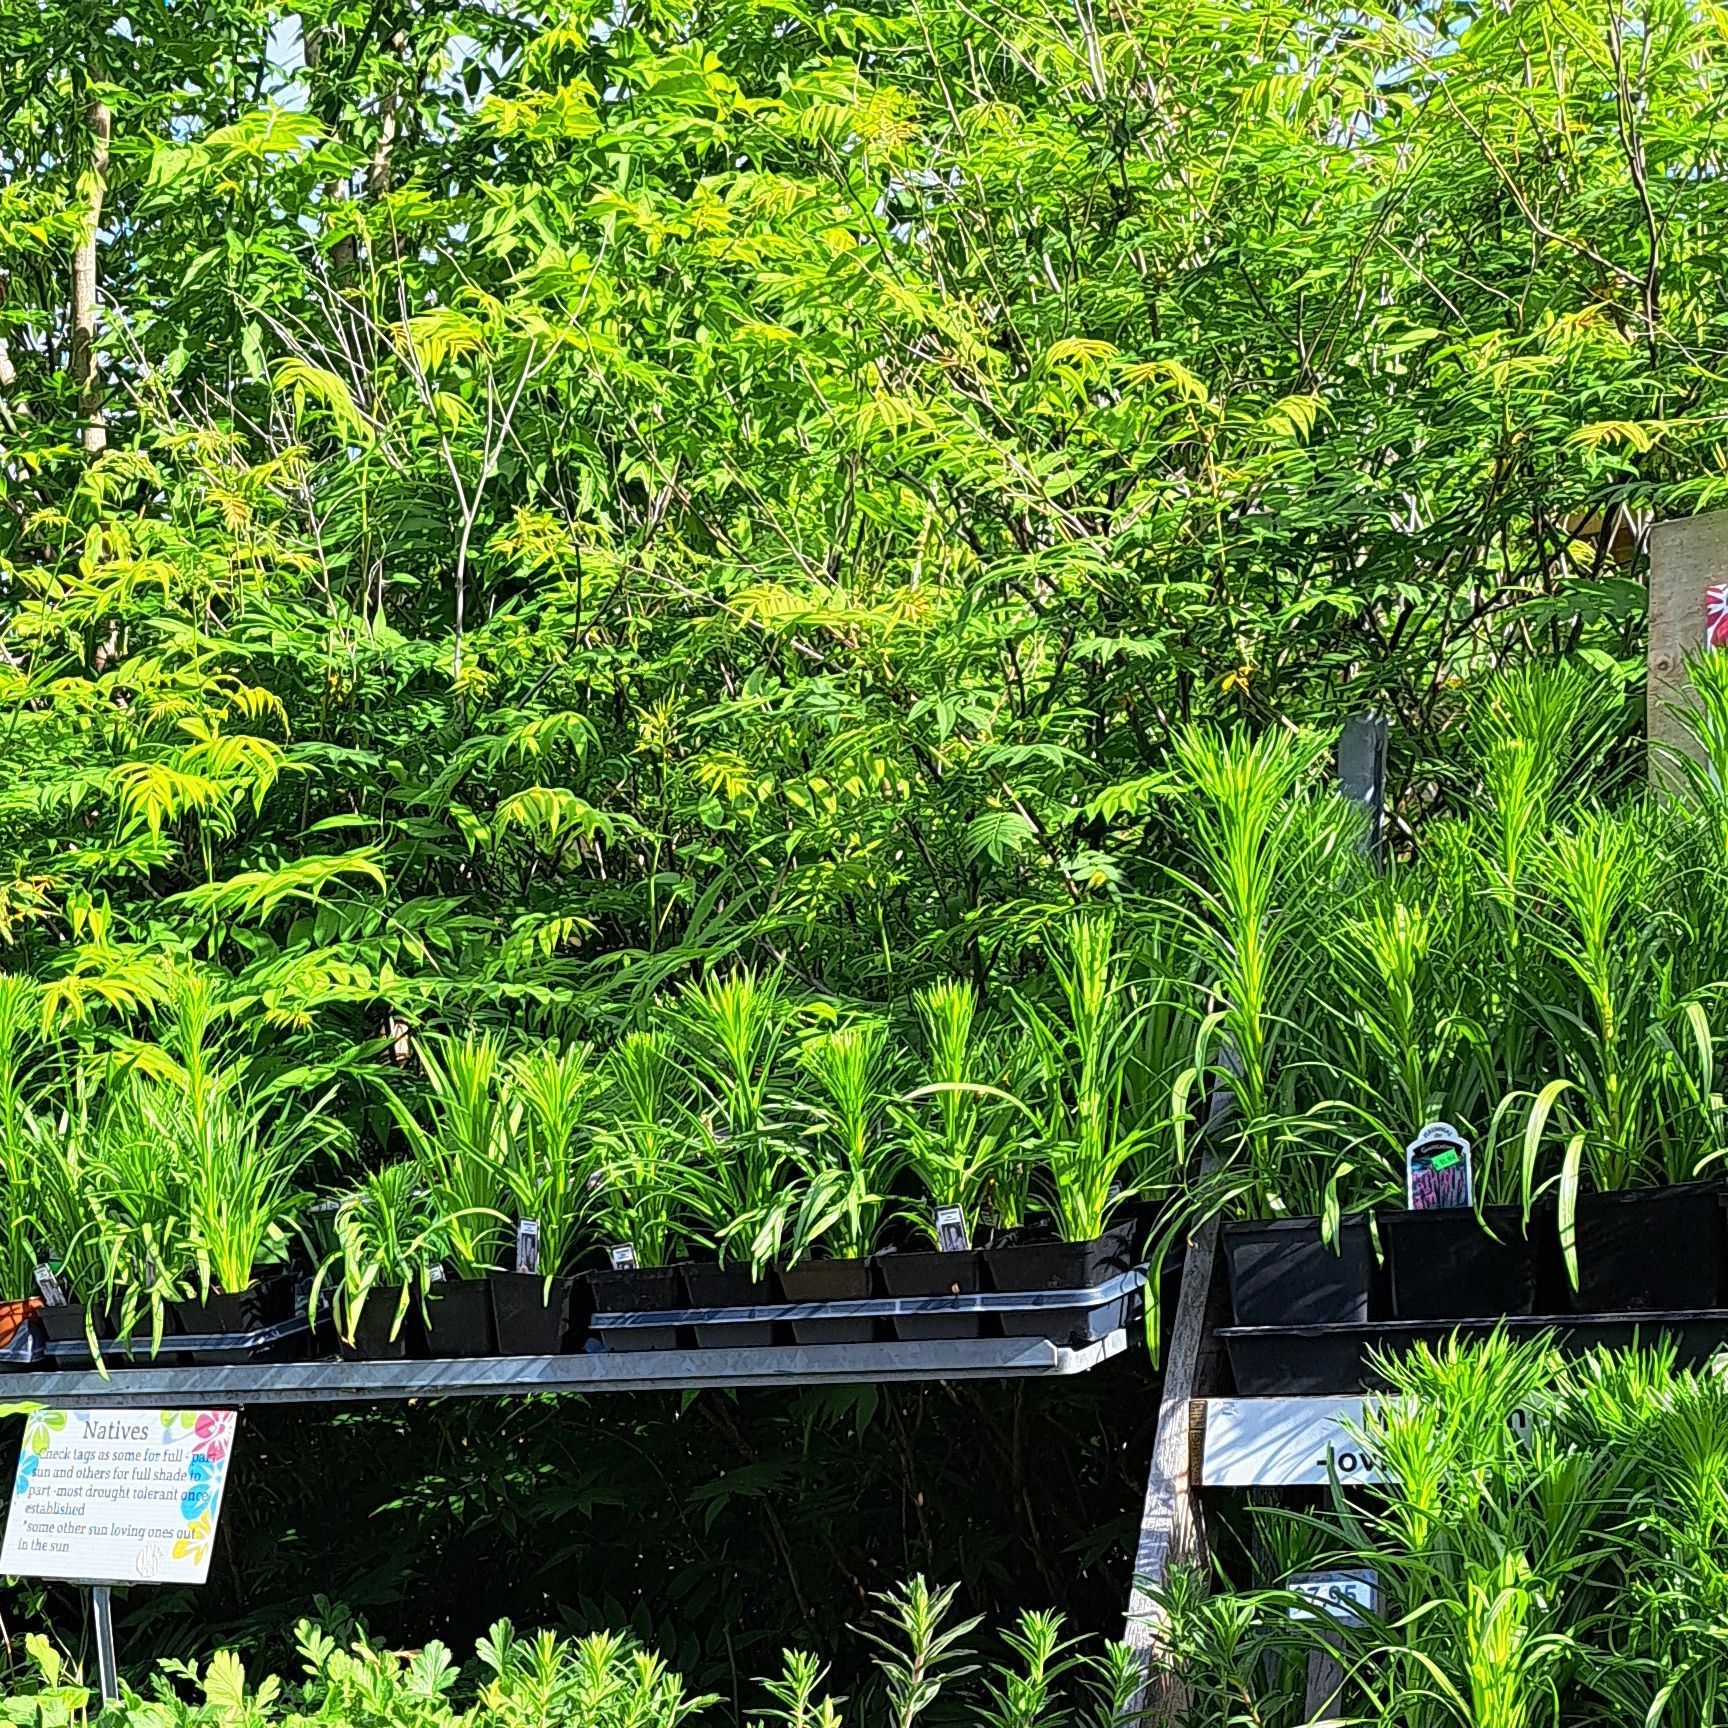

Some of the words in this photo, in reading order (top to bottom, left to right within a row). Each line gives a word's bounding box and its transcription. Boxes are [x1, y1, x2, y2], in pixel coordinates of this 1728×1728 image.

[82, 1420, 150, 1441] Natives
[73, 1450, 96, 1466] tags
[97, 1453, 110, 1462] as
[112, 1453, 141, 1462] some
[143, 1450, 161, 1462] for
[162, 1450, 183, 1463] full
[31, 1467, 51, 1478] sun
[53, 1466, 73, 1479] and
[75, 1466, 110, 1480] others
[112, 1467, 131, 1480] for
[131, 1468, 151, 1481] full
[153, 1468, 188, 1482] shade
[189, 1470, 202, 1482] to
[85, 1484, 130, 1502] drought
[132, 1486, 178, 1500] tolerant
[180, 1490, 209, 1501] once
[24, 1502, 86, 1516] established
[56, 1522, 87, 1536] other
[88, 1526, 108, 1536] sun
[110, 1523, 147, 1541] loving
[147, 1529, 175, 1539] ones
[176, 1528, 196, 1540] out
[17, 1537, 28, 1551] in
[30, 1538, 48, 1552] the
[50, 1542, 70, 1553] sun
